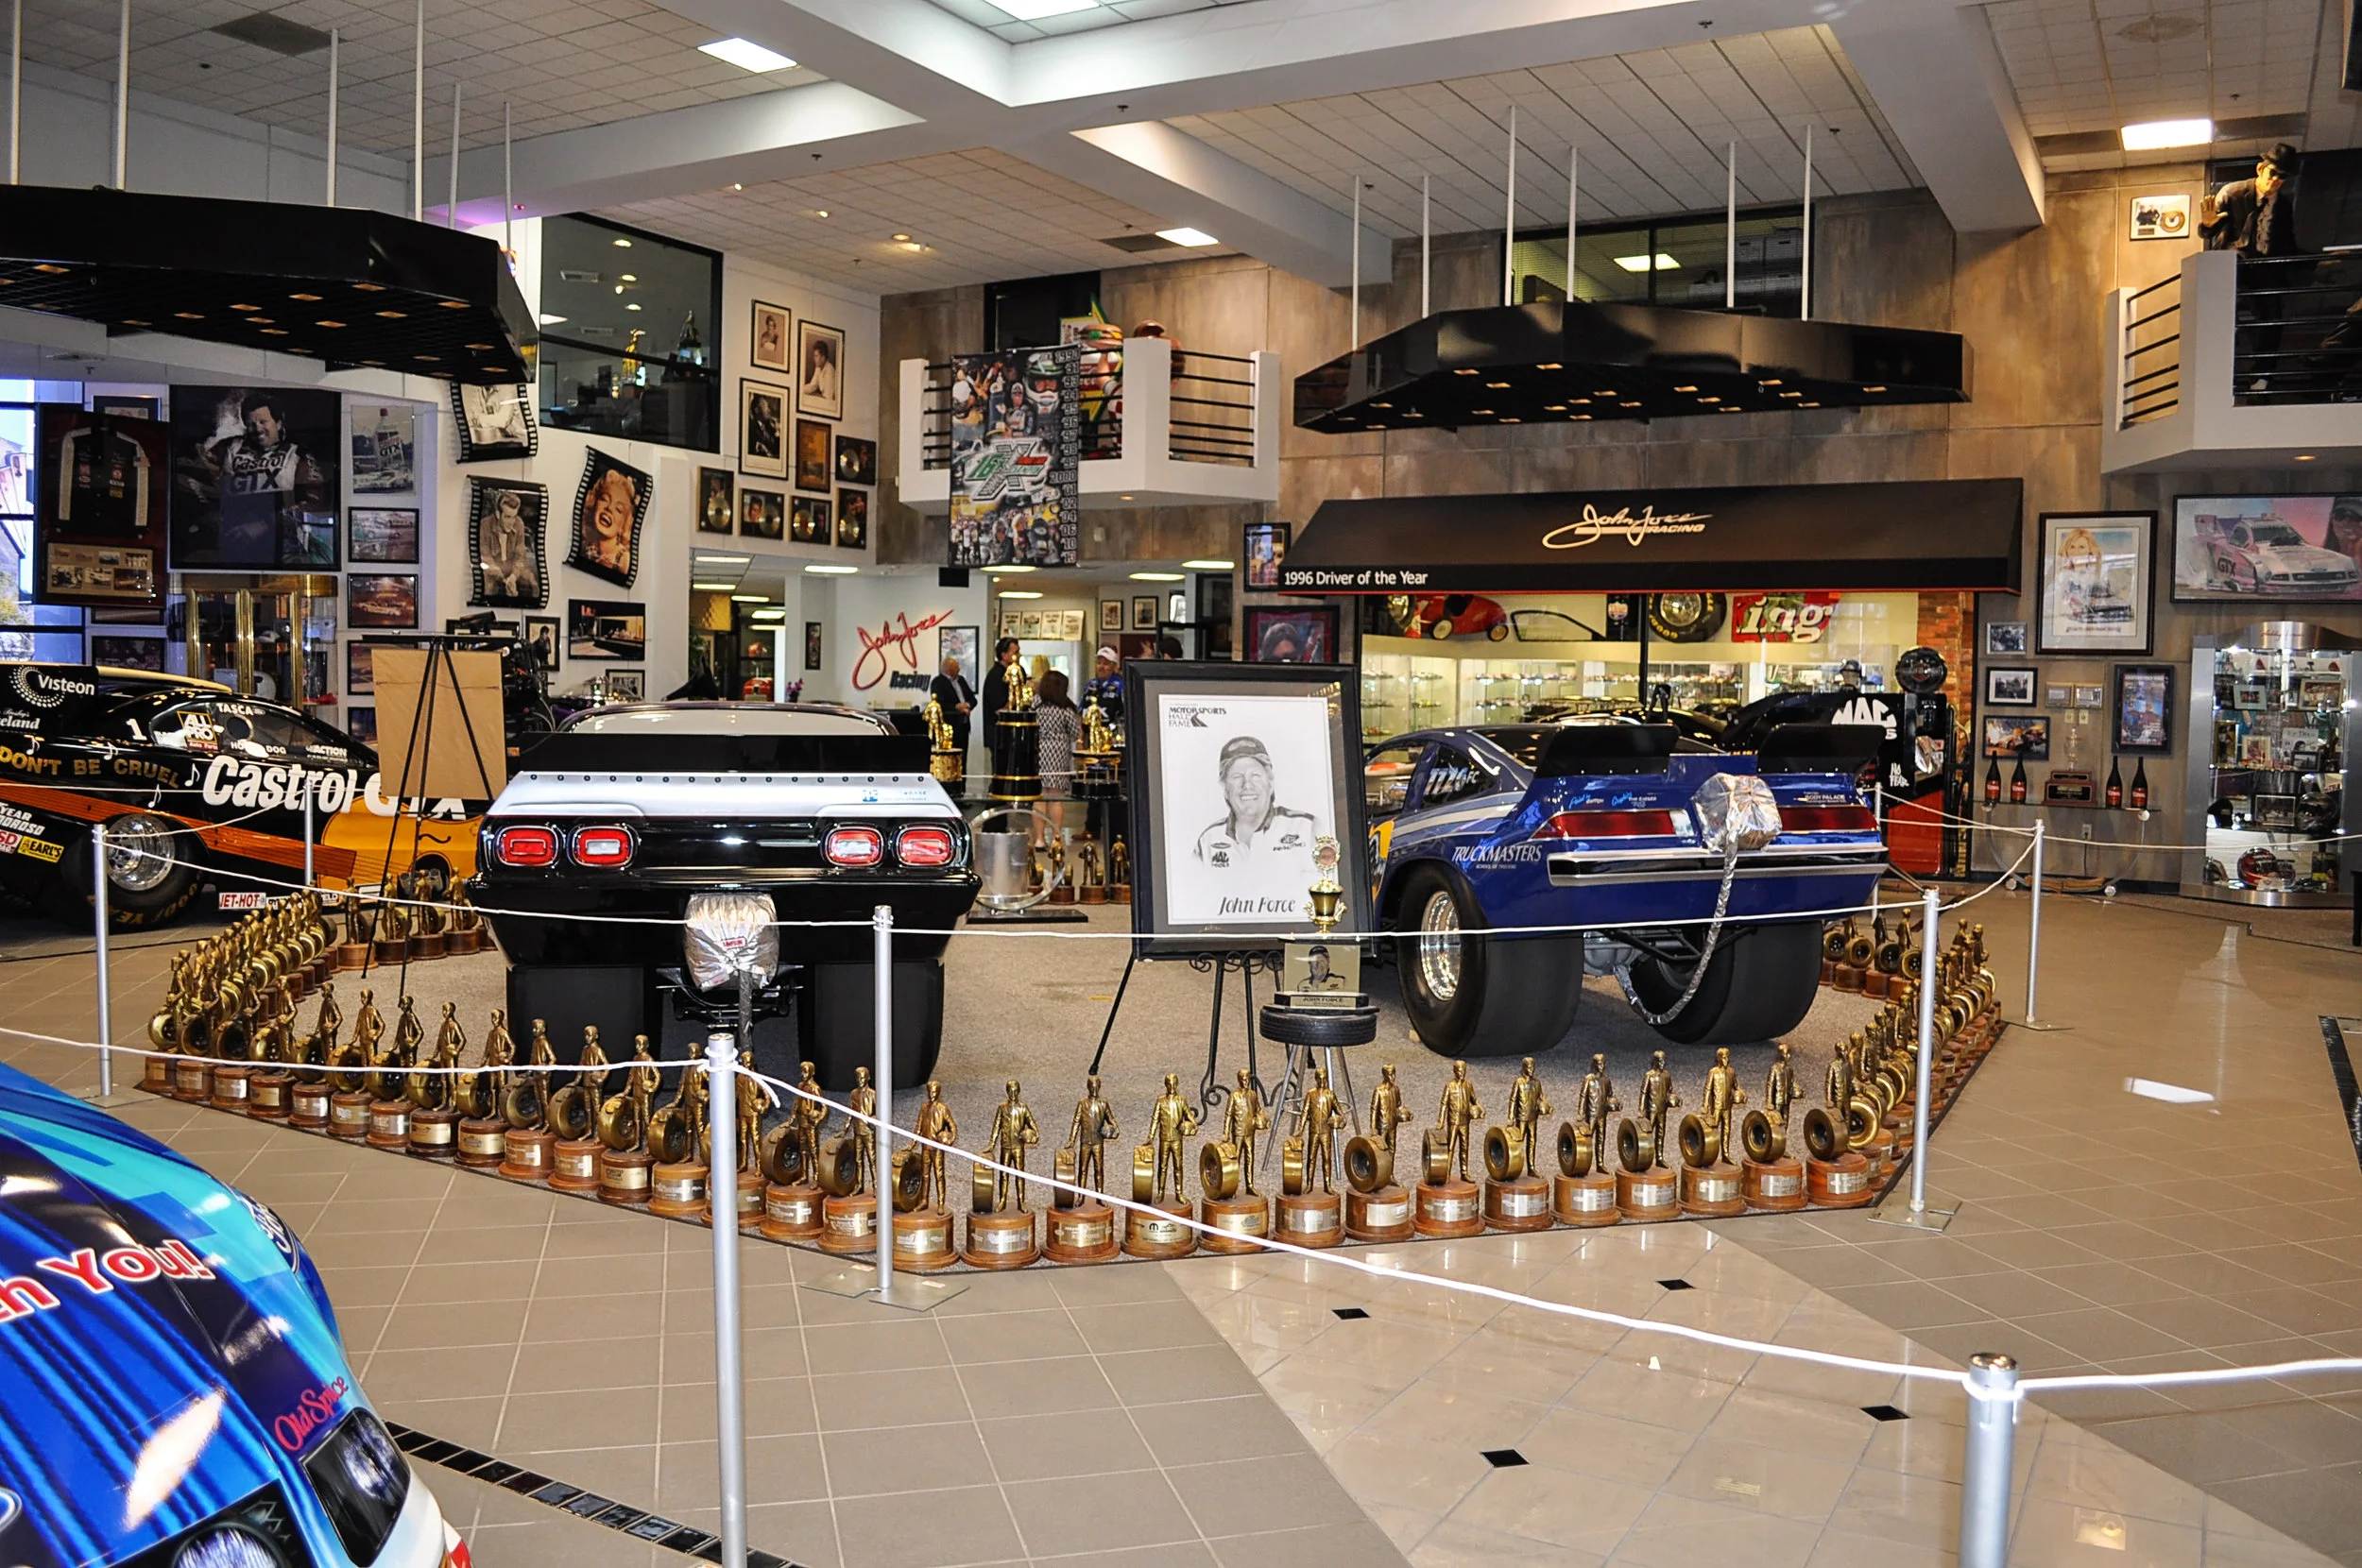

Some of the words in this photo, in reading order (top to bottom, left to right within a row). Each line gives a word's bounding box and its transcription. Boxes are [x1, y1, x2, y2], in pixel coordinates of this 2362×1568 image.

[1645, 524, 1706, 534] RACING
[1284, 571, 1313, 586] 1996
[1316, 571, 1354, 586] Driver
[1357, 571, 1372, 585] of
[1375, 571, 1396, 585] the
[1400, 571, 1428, 585] Year
[38, 674, 94, 696] Visteon
[216, 703, 253, 715] TASCA
[1831, 697, 1897, 727] MAC
[126, 718, 147, 741] 1
[184, 714, 212, 728] ALL
[265, 744, 286, 754] DOG
[0, 745, 62, 775] DON'T
[74, 759, 102, 775] BE
[113, 758, 180, 789] CRUEL
[1891, 763, 1901, 775] NO
[202, 756, 358, 813] Castrol
[1466, 771, 1480, 784] FC
[1451, 845, 1543, 862] TRUCKMASTERS
[219, 893, 260, 910] JET-HOT
[1218, 896, 1254, 915] John
[1258, 896, 1295, 913] Force
[36, 1239, 216, 1294] You!
[274, 1399, 316, 1451] Old
[300, 1376, 350, 1423] Spice
